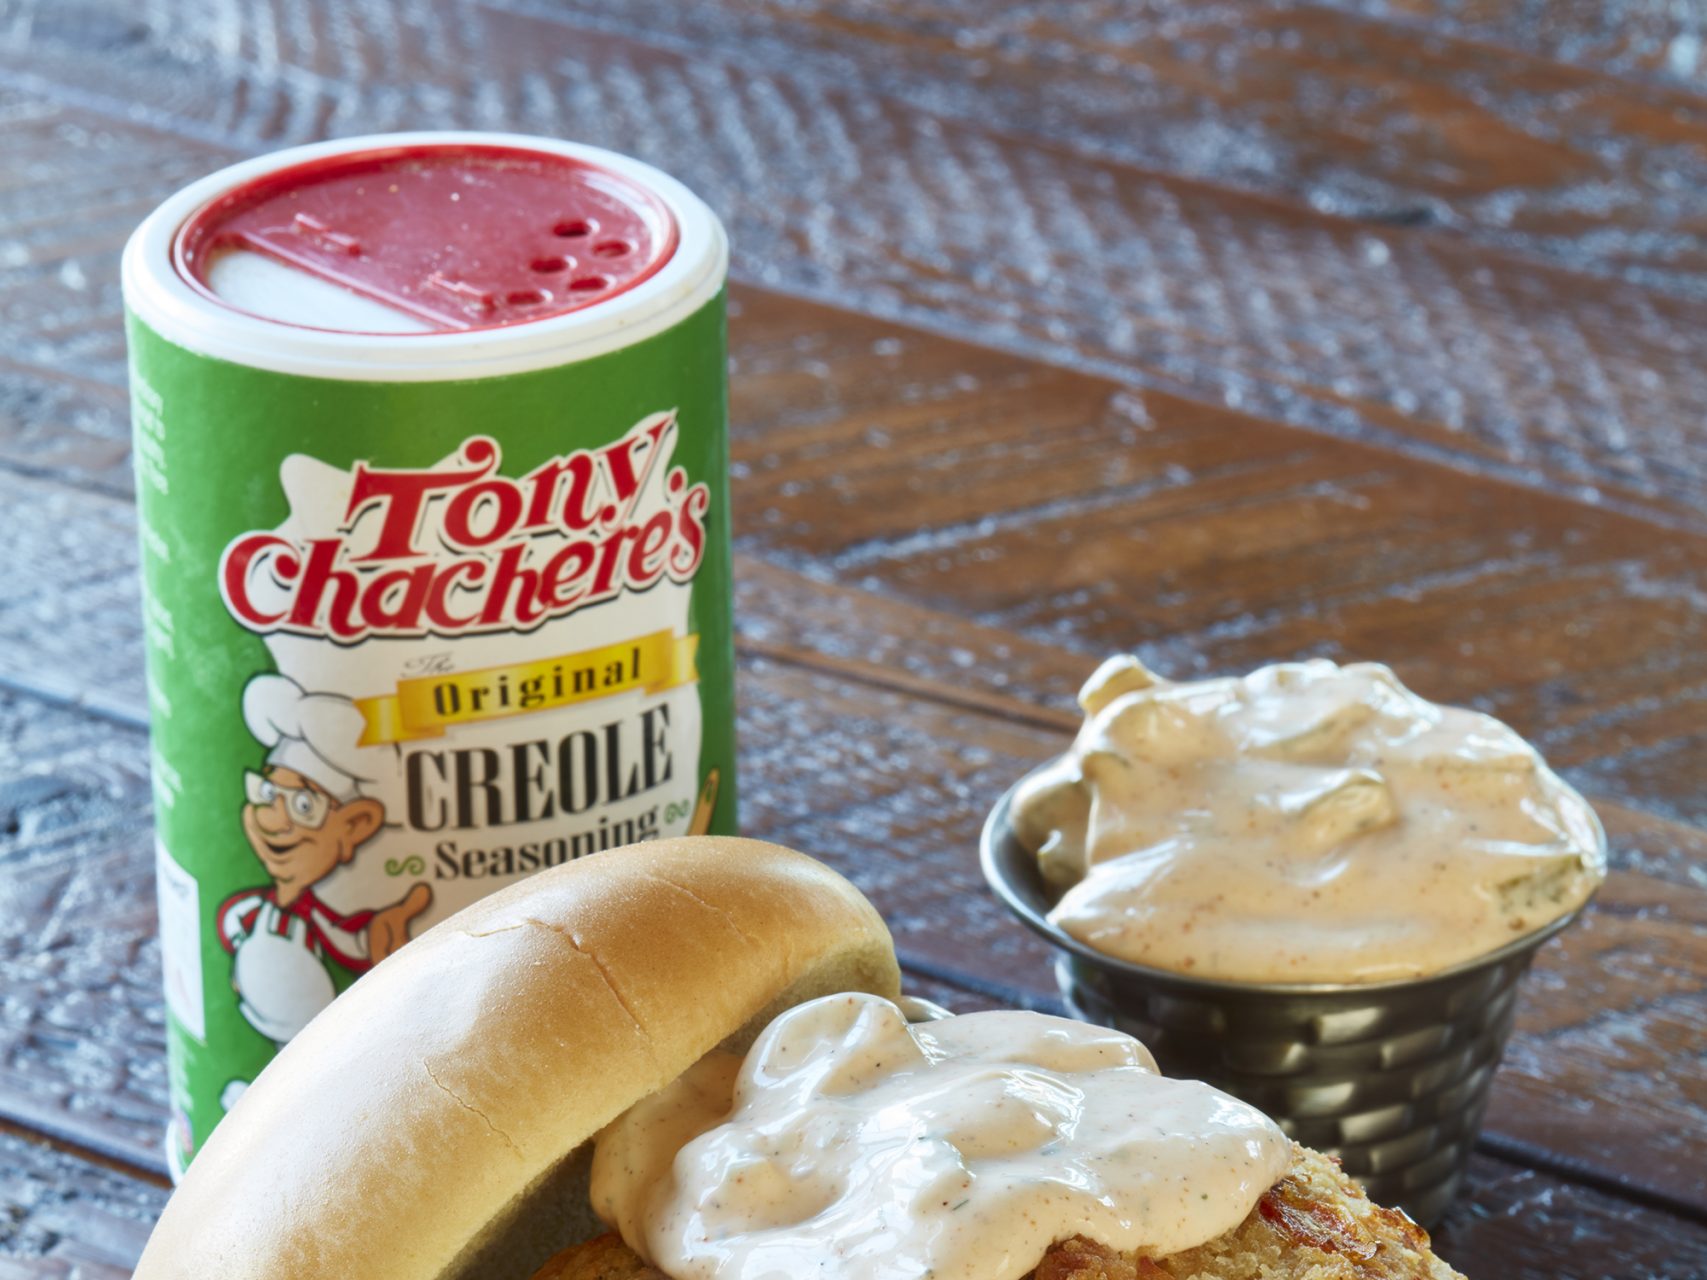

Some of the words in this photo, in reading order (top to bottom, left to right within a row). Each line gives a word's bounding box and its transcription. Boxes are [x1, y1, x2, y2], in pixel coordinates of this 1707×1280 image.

[343, 411, 676, 562] Tony
[223, 467, 708, 638] Chachere's
[433, 647, 641, 716] Original
[405, 702, 673, 832] CREOLE
[434, 804, 660, 880] Seasoning
